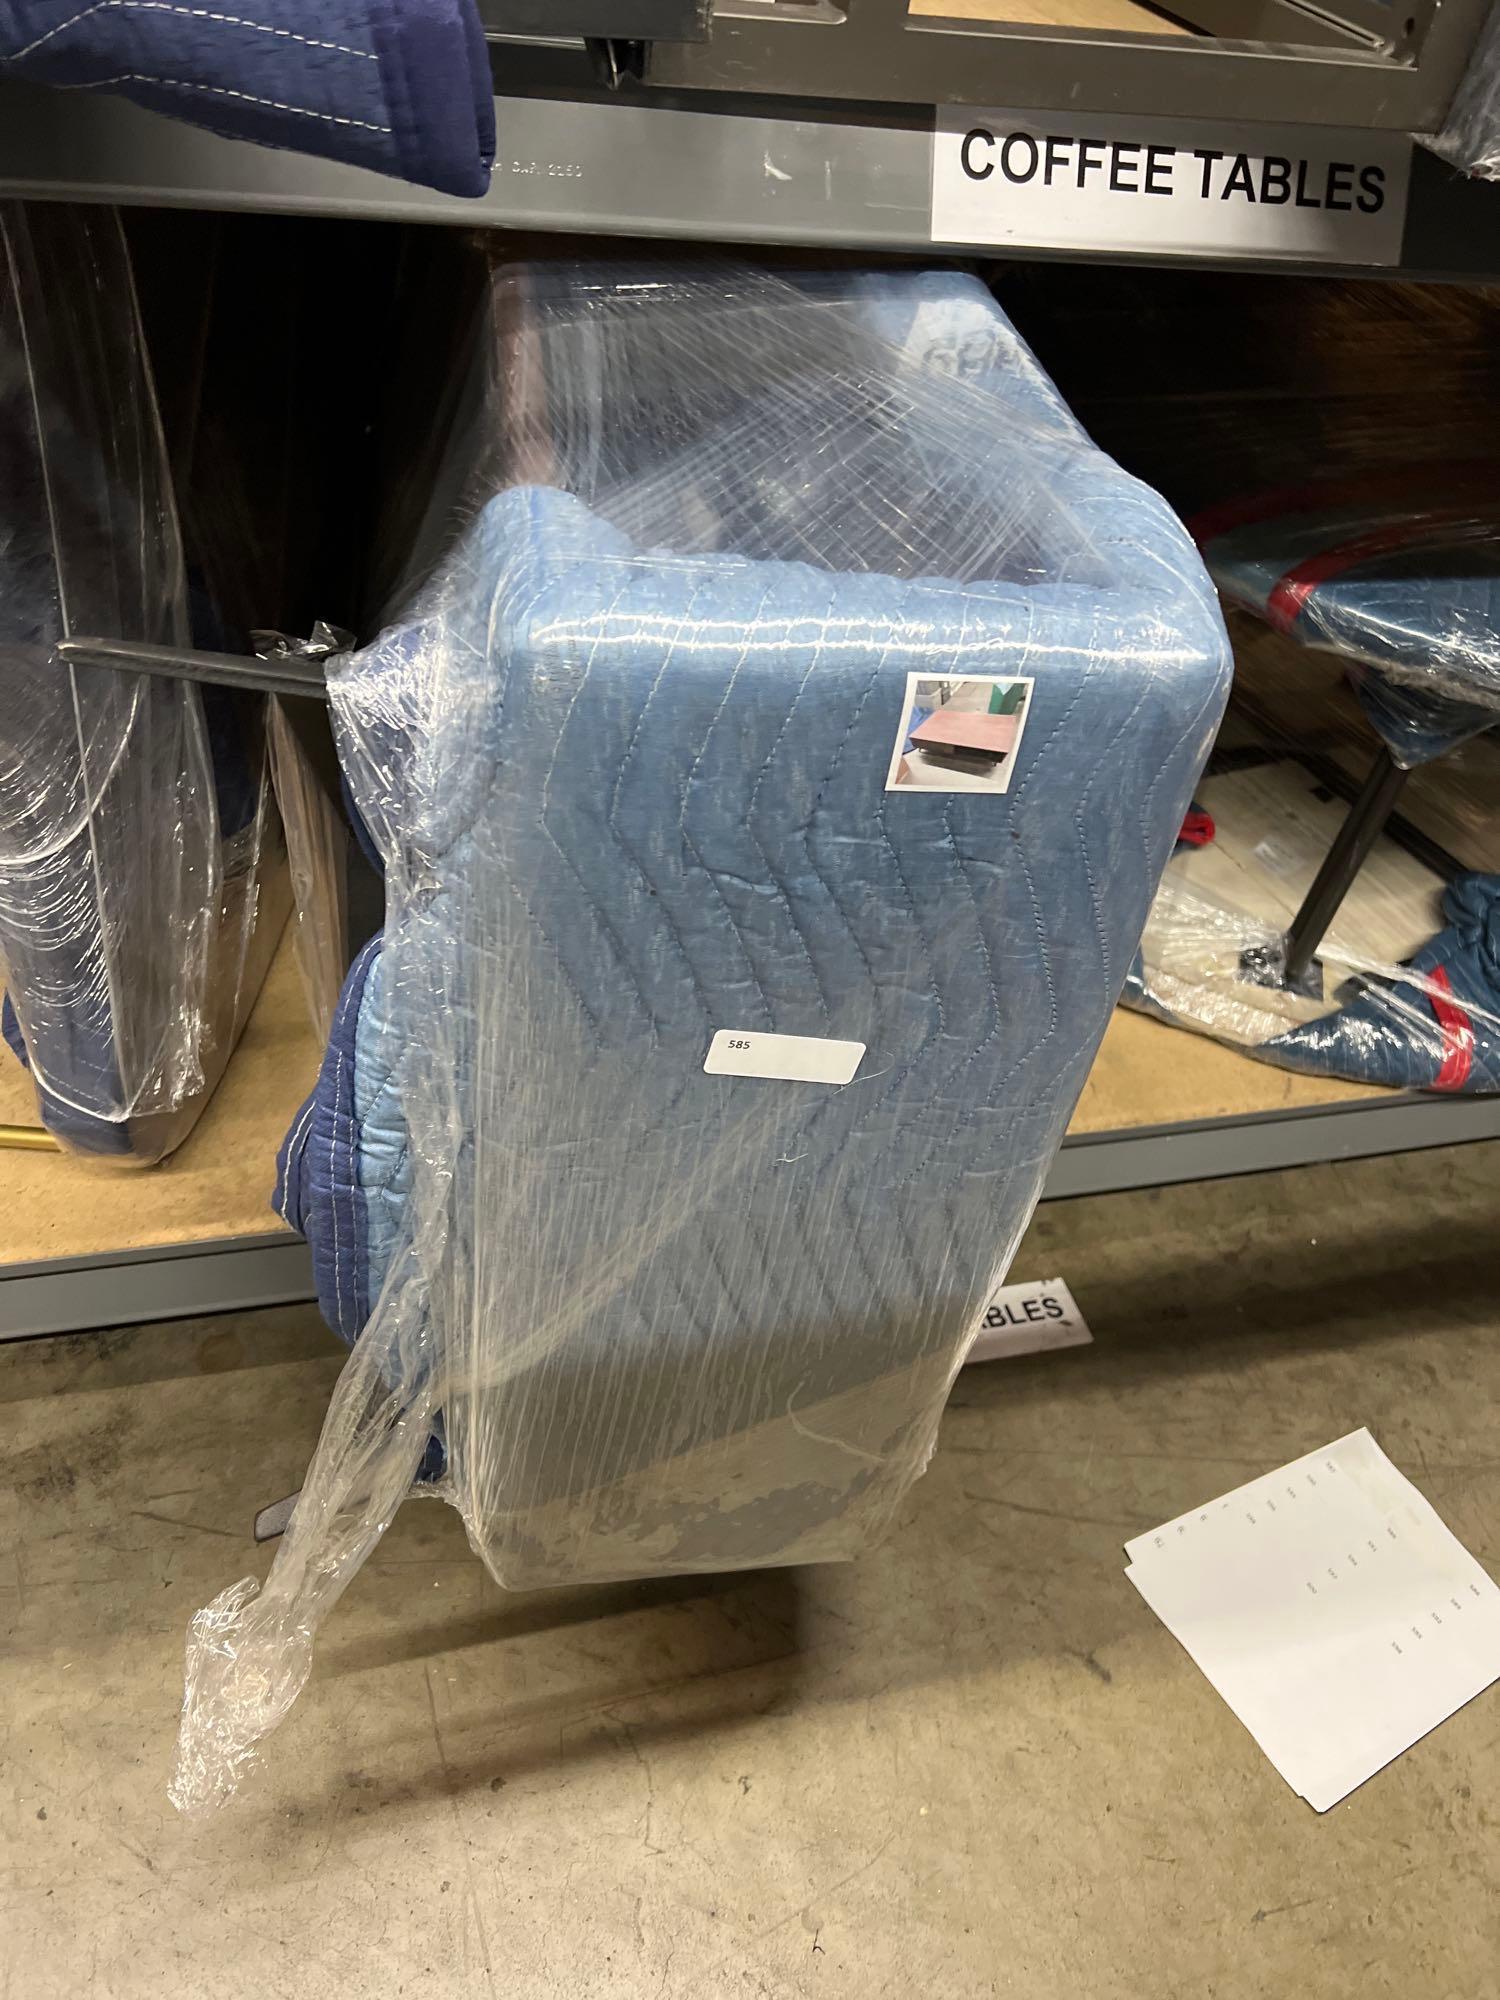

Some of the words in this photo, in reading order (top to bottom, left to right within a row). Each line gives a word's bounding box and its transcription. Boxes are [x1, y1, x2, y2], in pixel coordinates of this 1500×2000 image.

[961, 128, 1176, 196] COFFEE
[1194, 149, 1386, 214] TABLES
[727, 1040, 751, 1050] 585
[981, 1298, 1063, 1328] BLES
